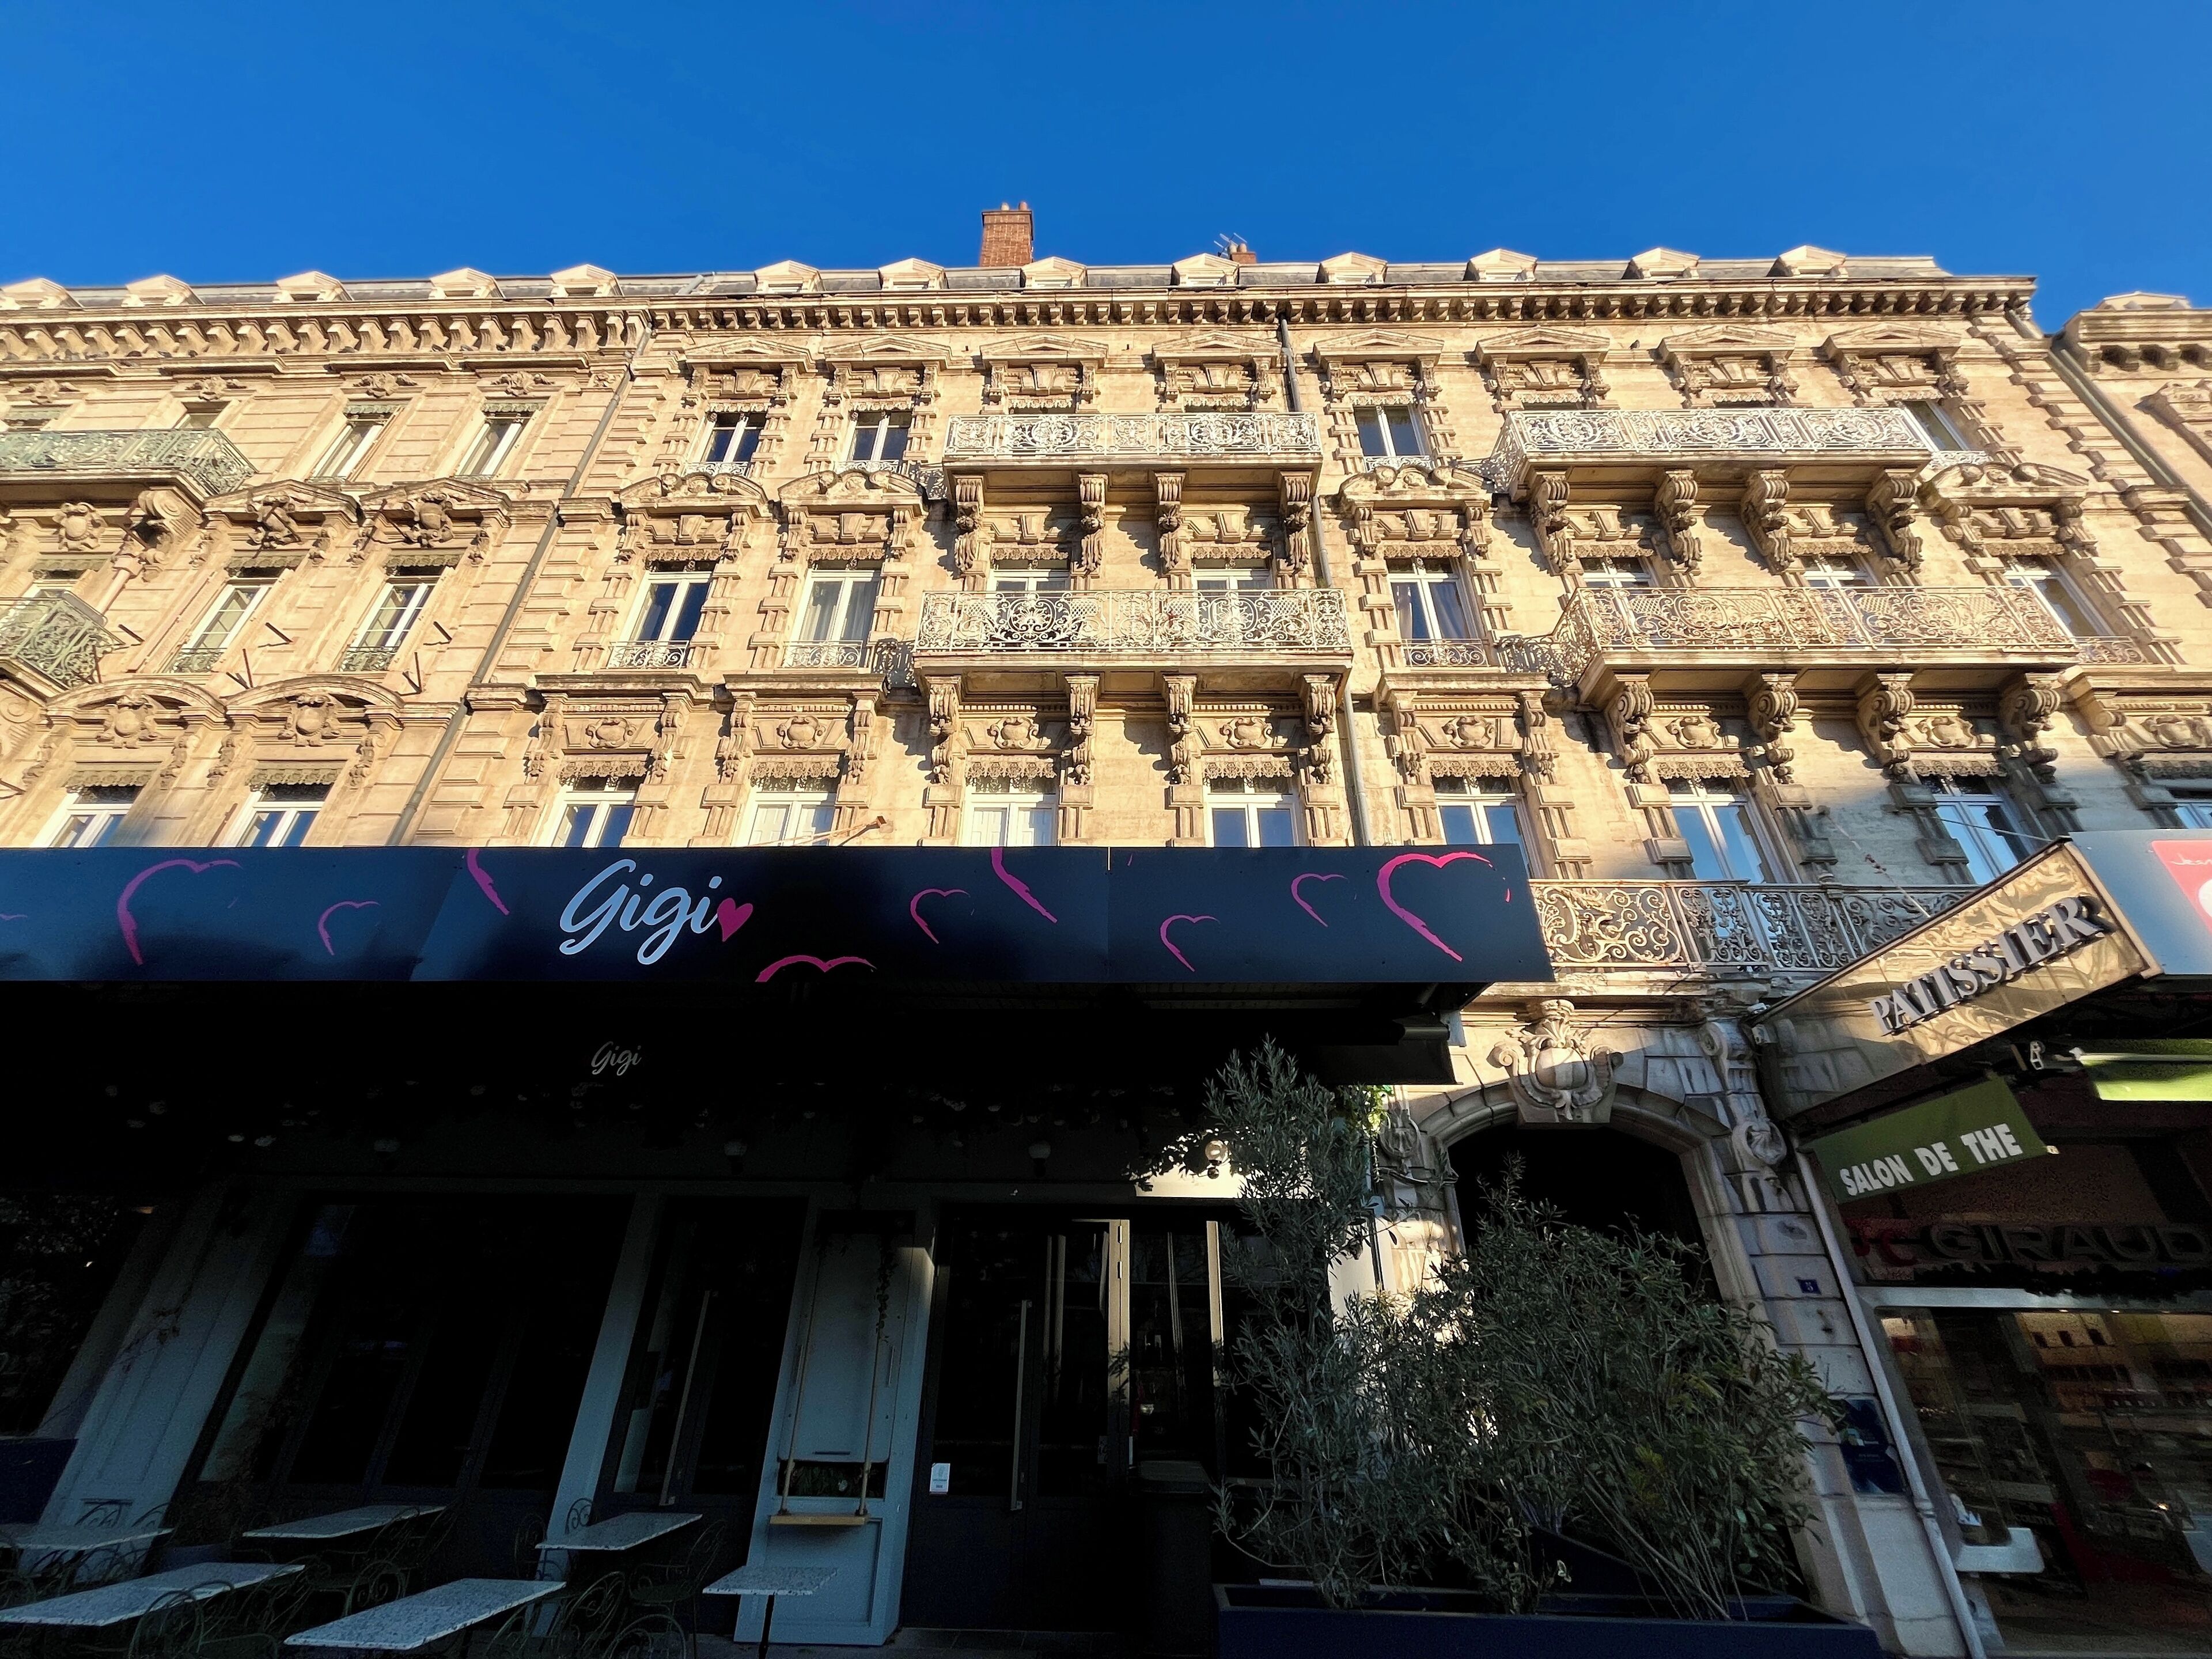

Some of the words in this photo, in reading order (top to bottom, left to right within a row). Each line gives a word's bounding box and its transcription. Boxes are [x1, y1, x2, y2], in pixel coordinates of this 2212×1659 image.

[559, 858, 722, 965] Gigi
[1870, 897, 2101, 1036] PATISSIER
[591, 1041, 642, 1076] Gigi
[1840, 1154, 1915, 1196] SALON
[1914, 1142, 1960, 1176] DE
[1960, 1123, 2024, 1164] THE
[1929, 1222, 2211, 1263] GIRAUD
